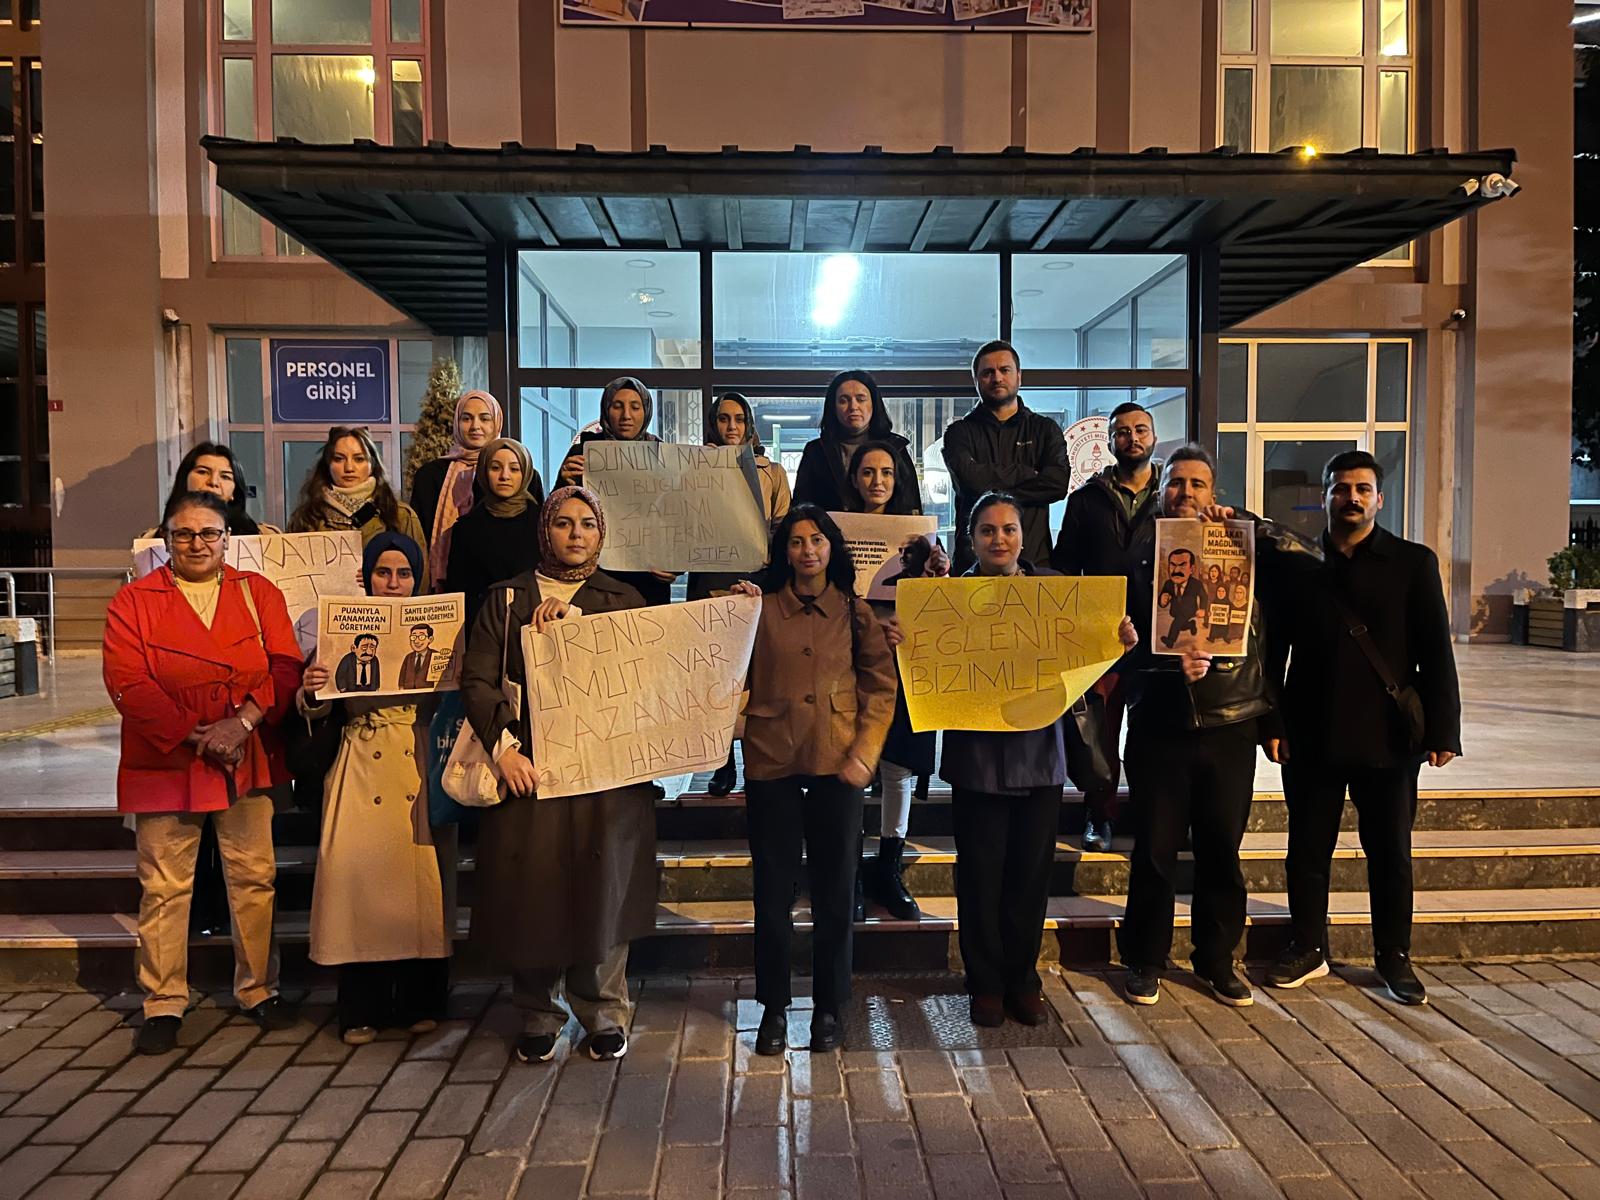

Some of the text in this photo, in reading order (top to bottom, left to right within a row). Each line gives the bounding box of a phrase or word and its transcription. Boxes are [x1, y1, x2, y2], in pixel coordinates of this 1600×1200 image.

[286, 362, 375, 377] PERSONEL
[306, 381, 357, 404] GİRİŞİ
[603, 527, 652, 549] USUF
[914, 579, 1079, 621] AĞAM
[340, 622, 380, 631] ÖĞRETMEN
[529, 600, 749, 669] DİRENİŞ VAR
[910, 614, 1085, 661] EĞLENİR
[536, 643, 730, 711] UMUT VAR
